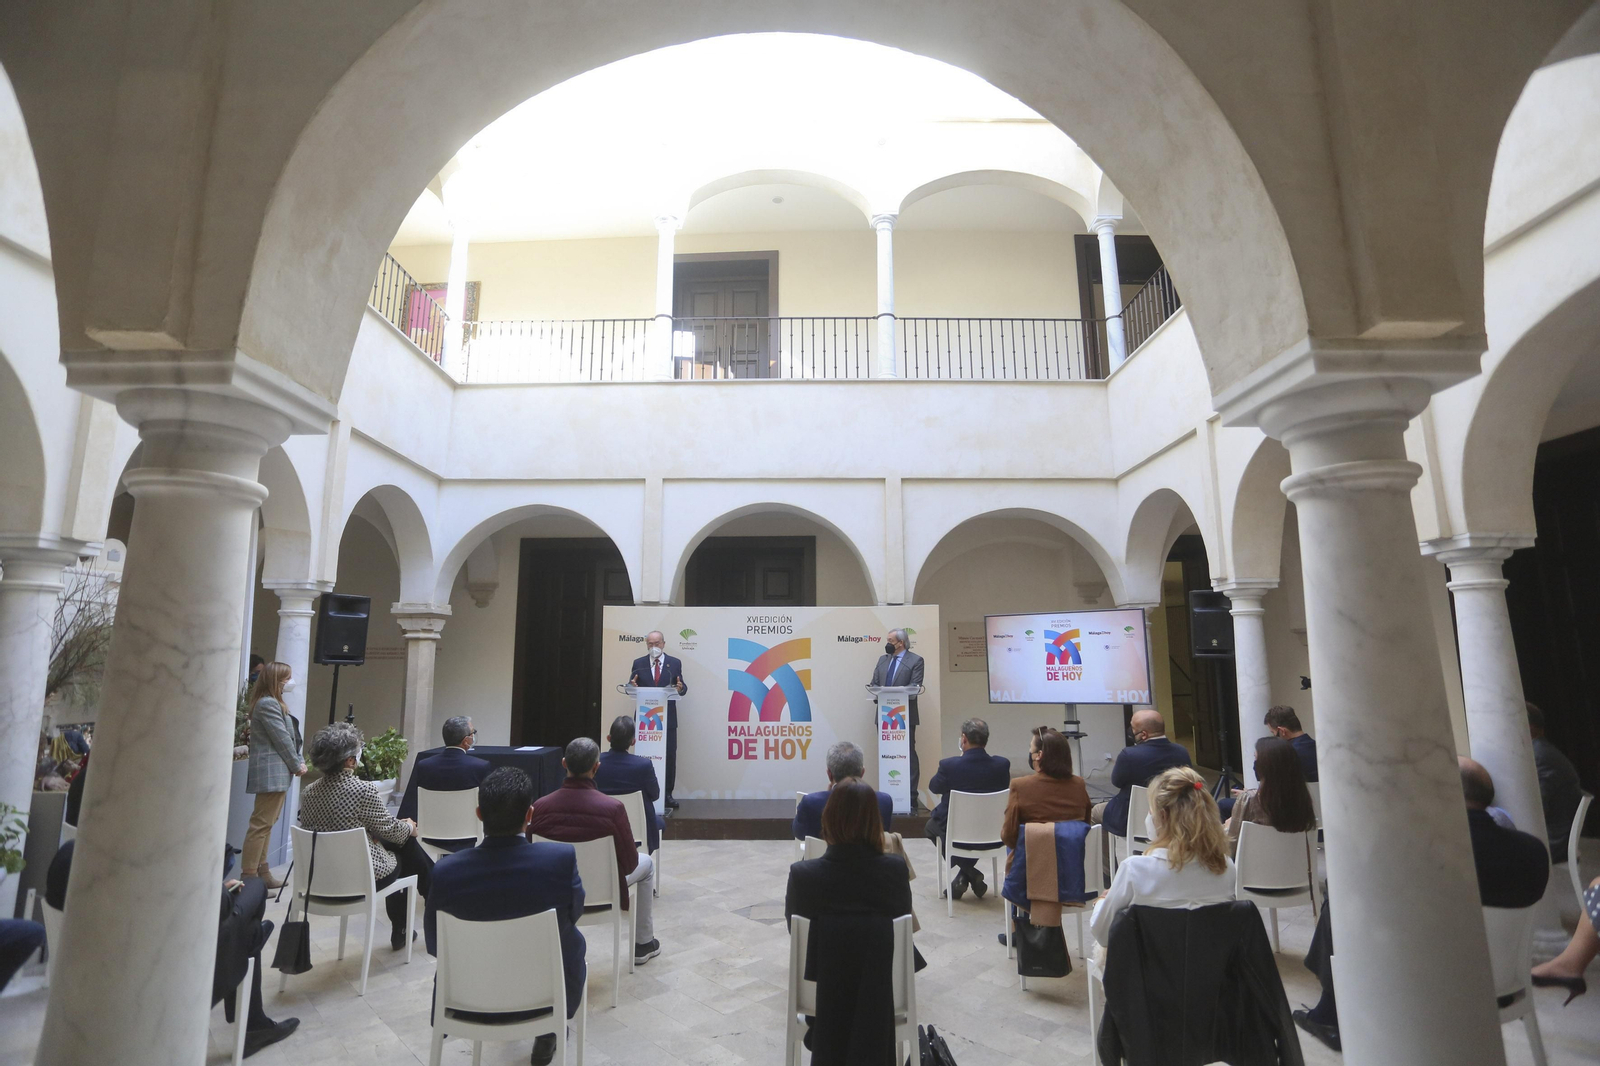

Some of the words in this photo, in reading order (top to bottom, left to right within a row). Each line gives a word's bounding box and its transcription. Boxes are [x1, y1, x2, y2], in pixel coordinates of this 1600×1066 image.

[746, 625, 793, 635] PREMIOS
[618, 634, 644, 643] Málaga
[837, 635, 863, 643] Málaga
[868, 635, 881, 643] hoy
[1046, 671, 1060, 681] DE
[1062, 671, 1082, 681] HOY
[1116, 690, 1149, 703] HOY
[728, 723, 813, 737] MALAGUEÑOS
[728, 738, 758, 760] DE
[764, 738, 812, 760] HOY
